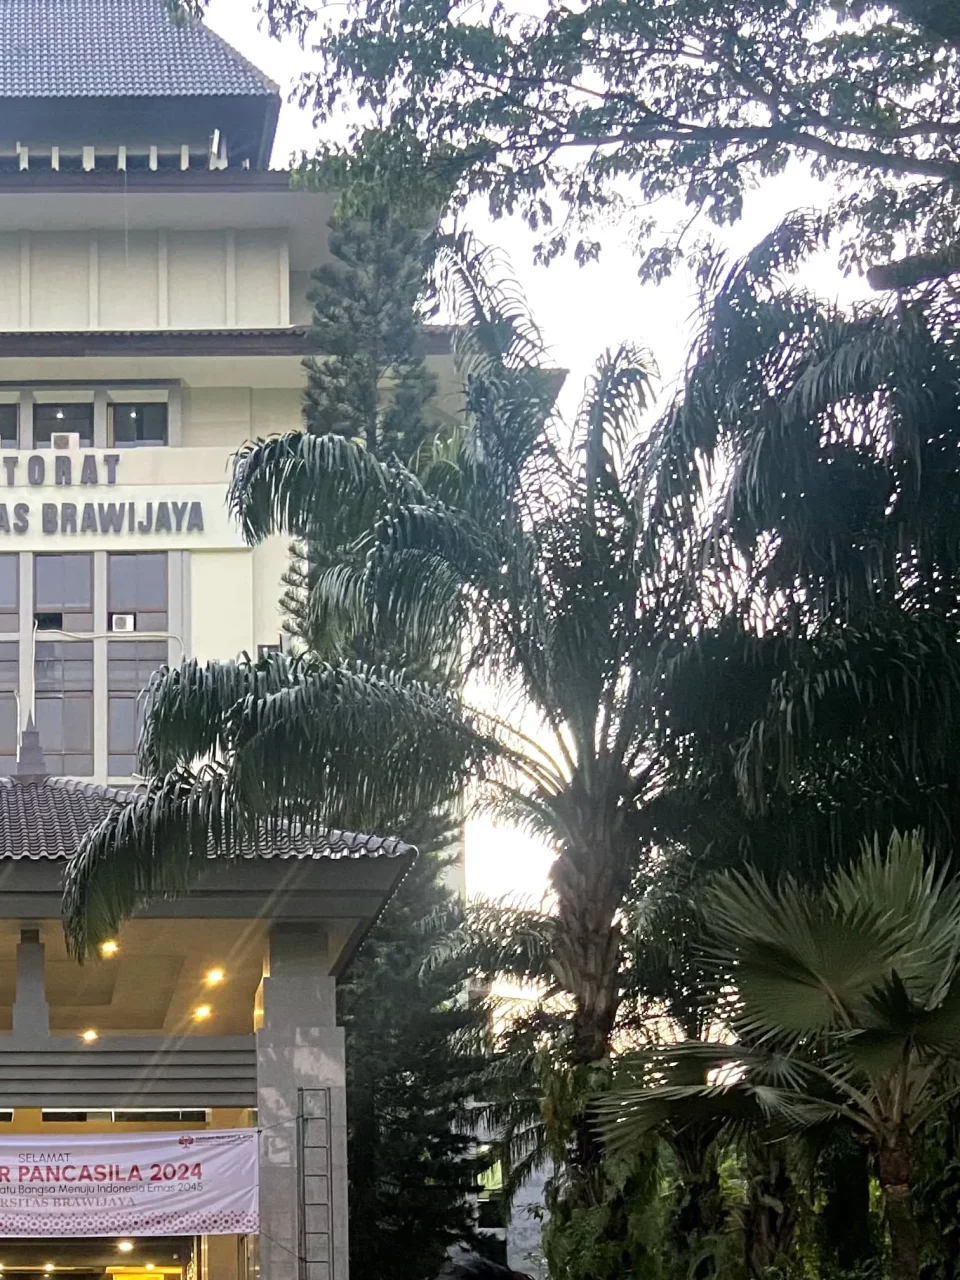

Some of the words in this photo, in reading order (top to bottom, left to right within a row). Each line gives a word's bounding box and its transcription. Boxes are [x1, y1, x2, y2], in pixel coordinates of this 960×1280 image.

[42, 502, 204, 535] BRAWIJAYA
[18, 1153, 71, 1163] SELAMAT
[18, 1165, 143, 1183] PANCASILA
[150, 1163, 203, 1181] 2024
[18, 1185, 56, 1196] Bangsa
[59, 1185, 95, 1194] Menuju
[97, 1184, 145, 1193] Indonesia
[147, 1184, 175, 1193] Emas
[178, 1182, 203, 1192] 2045
[53, 1197, 136, 1207] BRAWIJAYA
